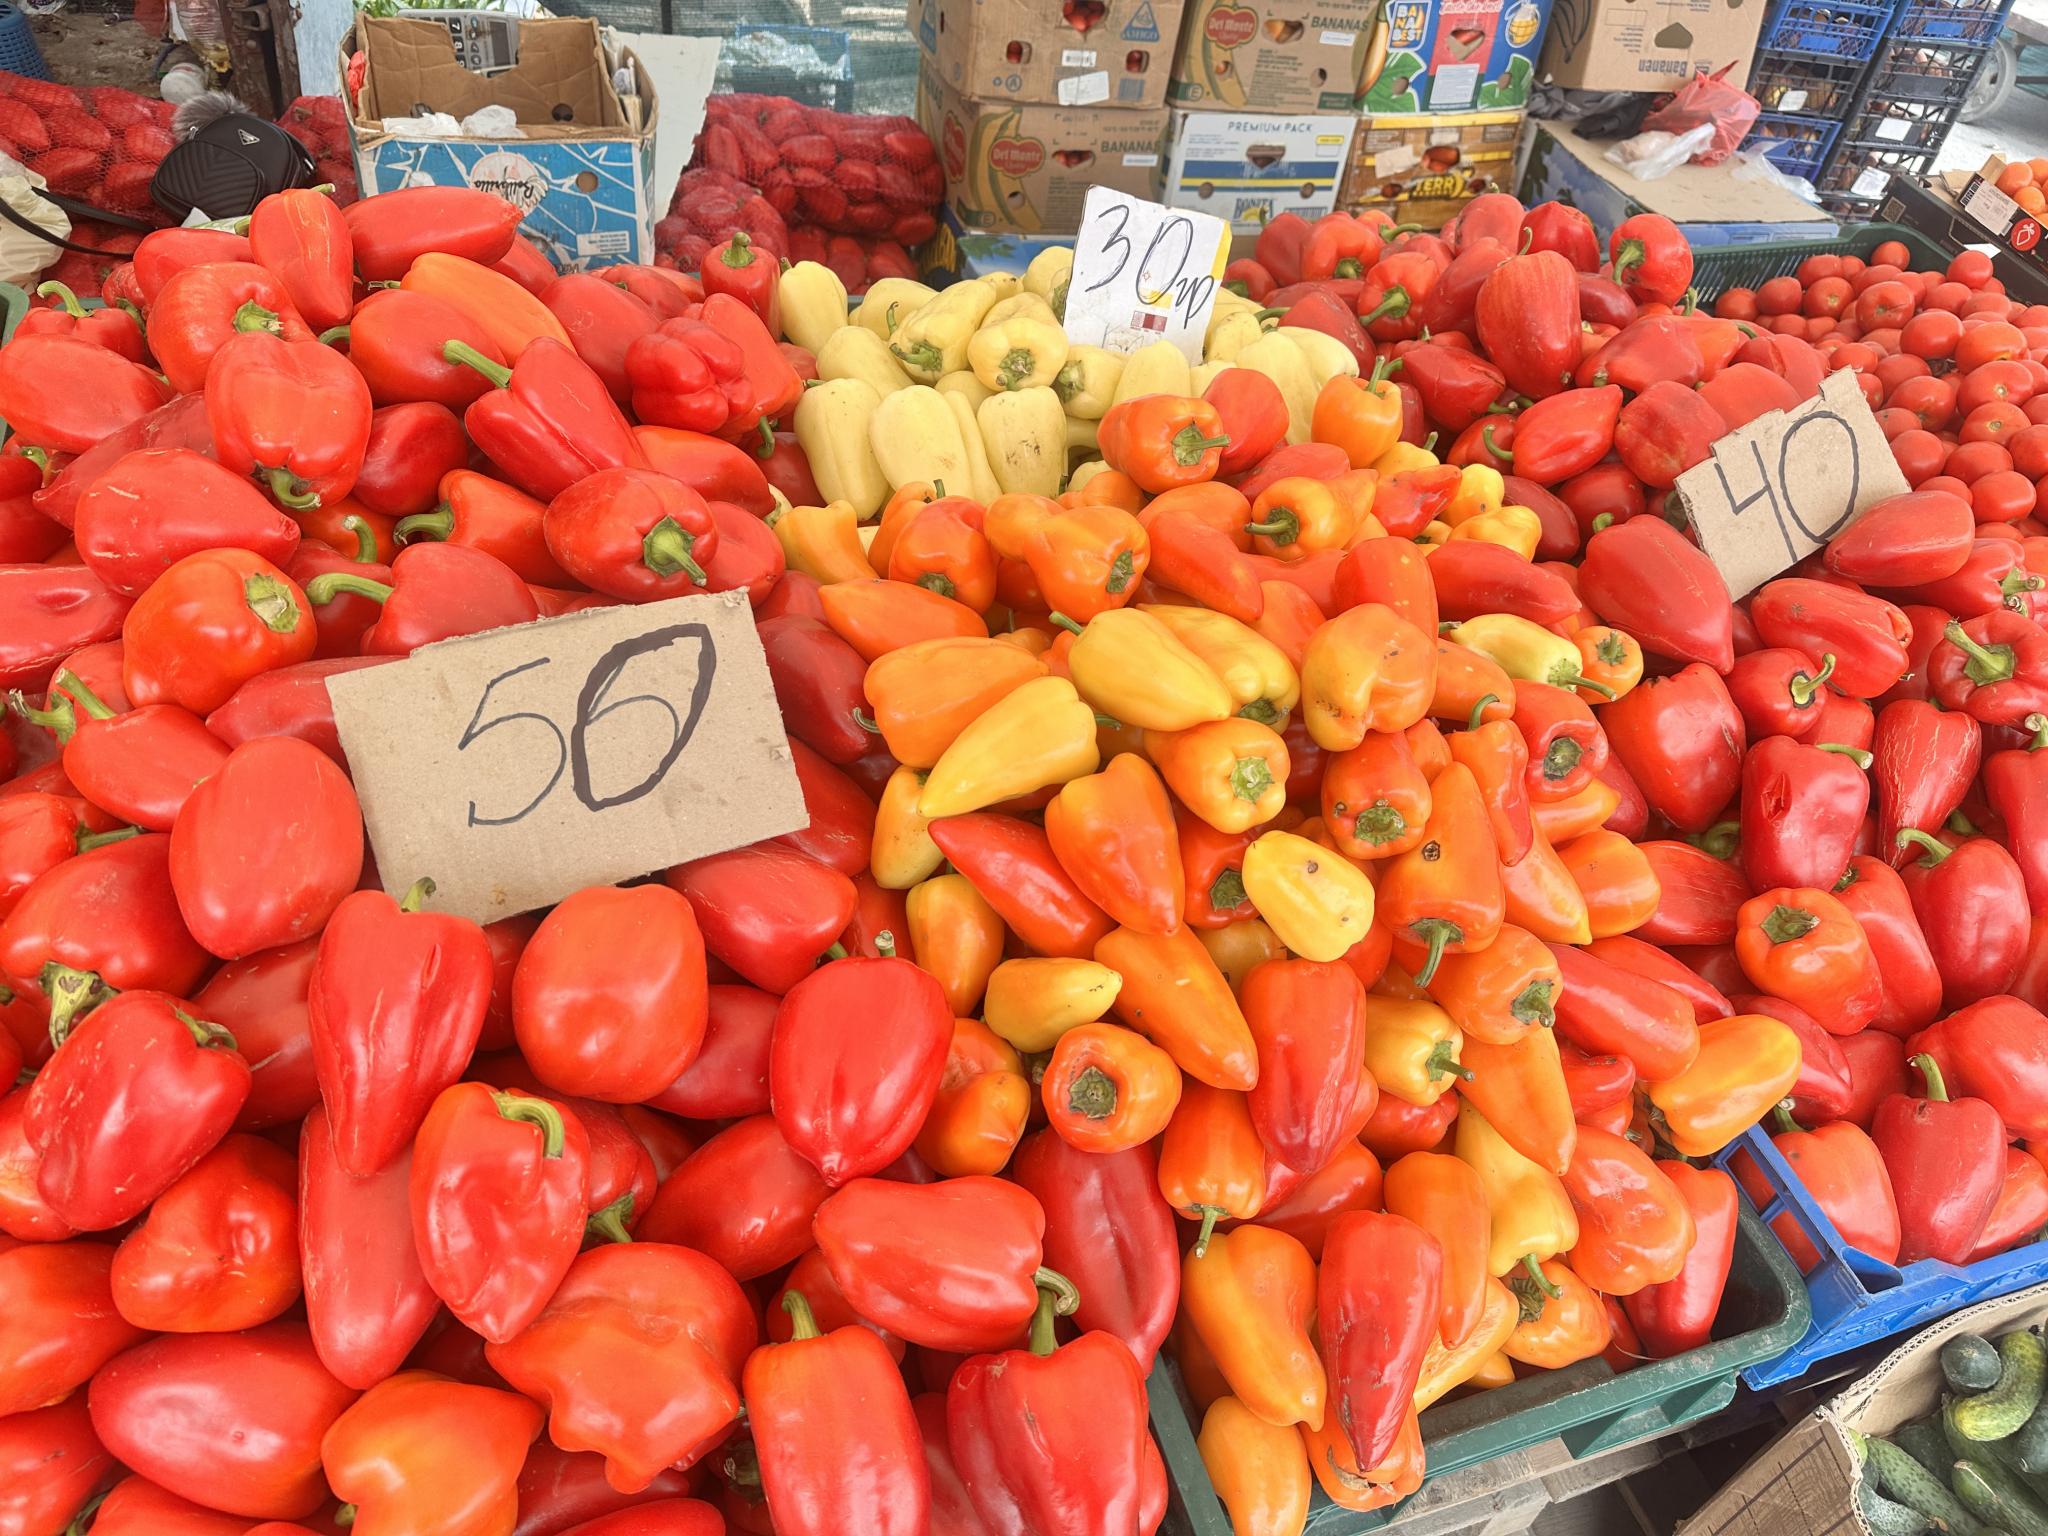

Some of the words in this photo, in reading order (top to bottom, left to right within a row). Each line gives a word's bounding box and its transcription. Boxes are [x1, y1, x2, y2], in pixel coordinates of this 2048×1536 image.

[1311, 16, 1369, 32] BANANAS
[1638, 59, 1688, 77] Bananen
[1228, 121, 1280, 133] PREMIUM
[1284, 122, 1313, 133] PACK
[1101, 140, 1159, 155] BANANAS
[1085, 203, 1194, 306] 30
[1713, 410, 1860, 563] 40
[458, 622, 717, 828] 50
